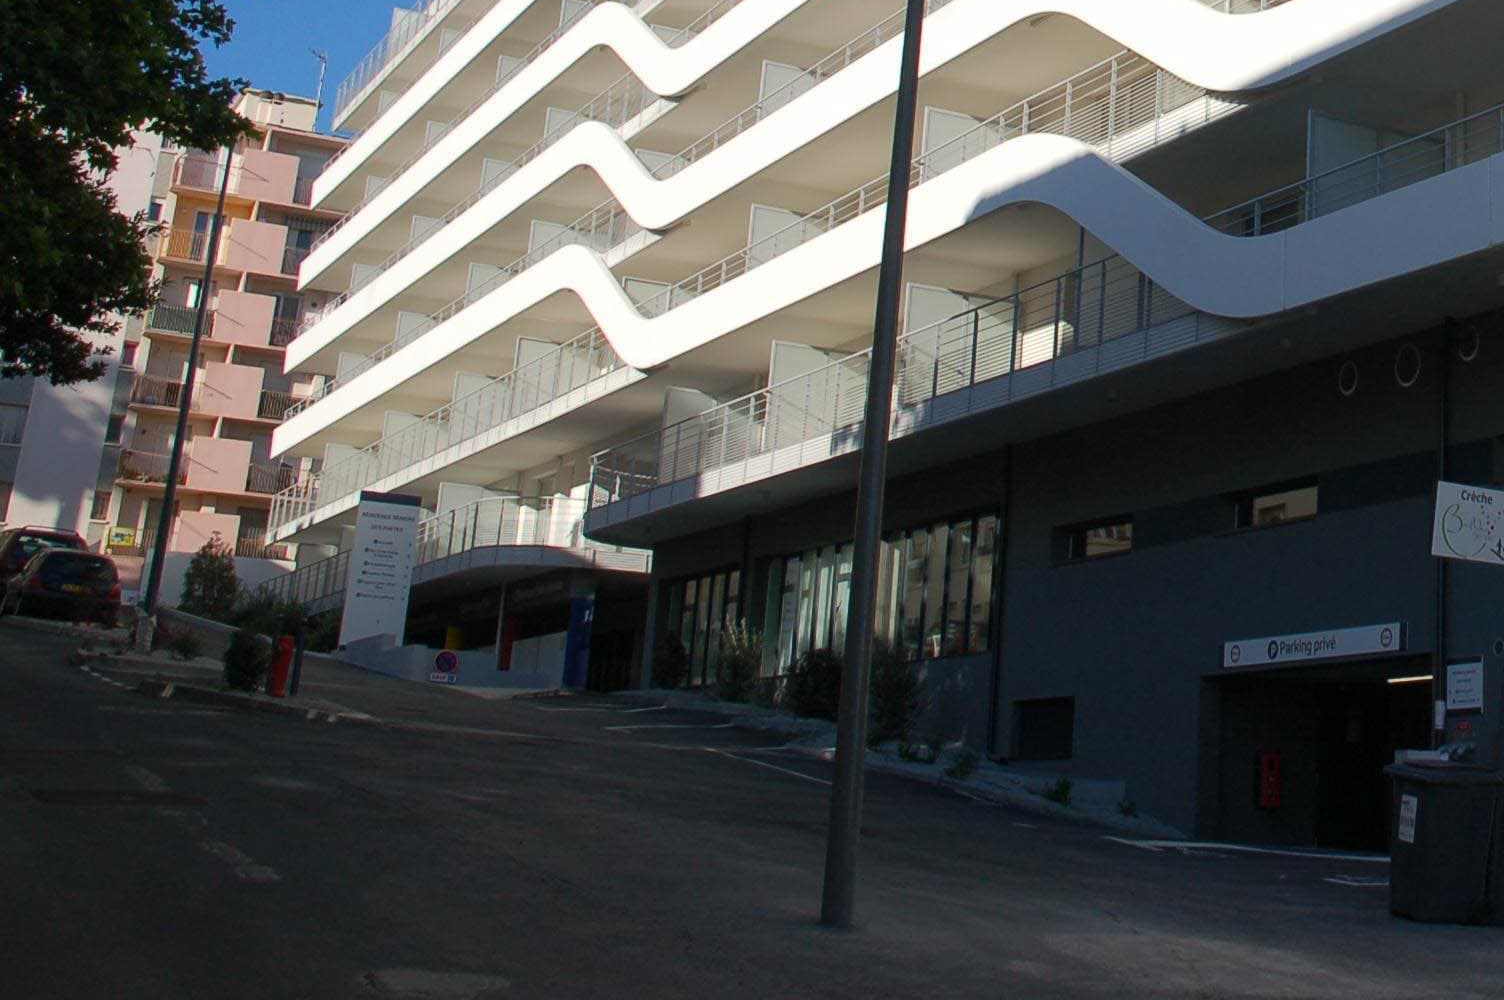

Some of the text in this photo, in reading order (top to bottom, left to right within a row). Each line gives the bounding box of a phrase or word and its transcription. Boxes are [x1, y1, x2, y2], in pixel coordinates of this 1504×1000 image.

[1460, 489, 1493, 505] Crèche
[1280, 639, 1312, 656] Parking
[1313, 633, 1336, 656] privé
